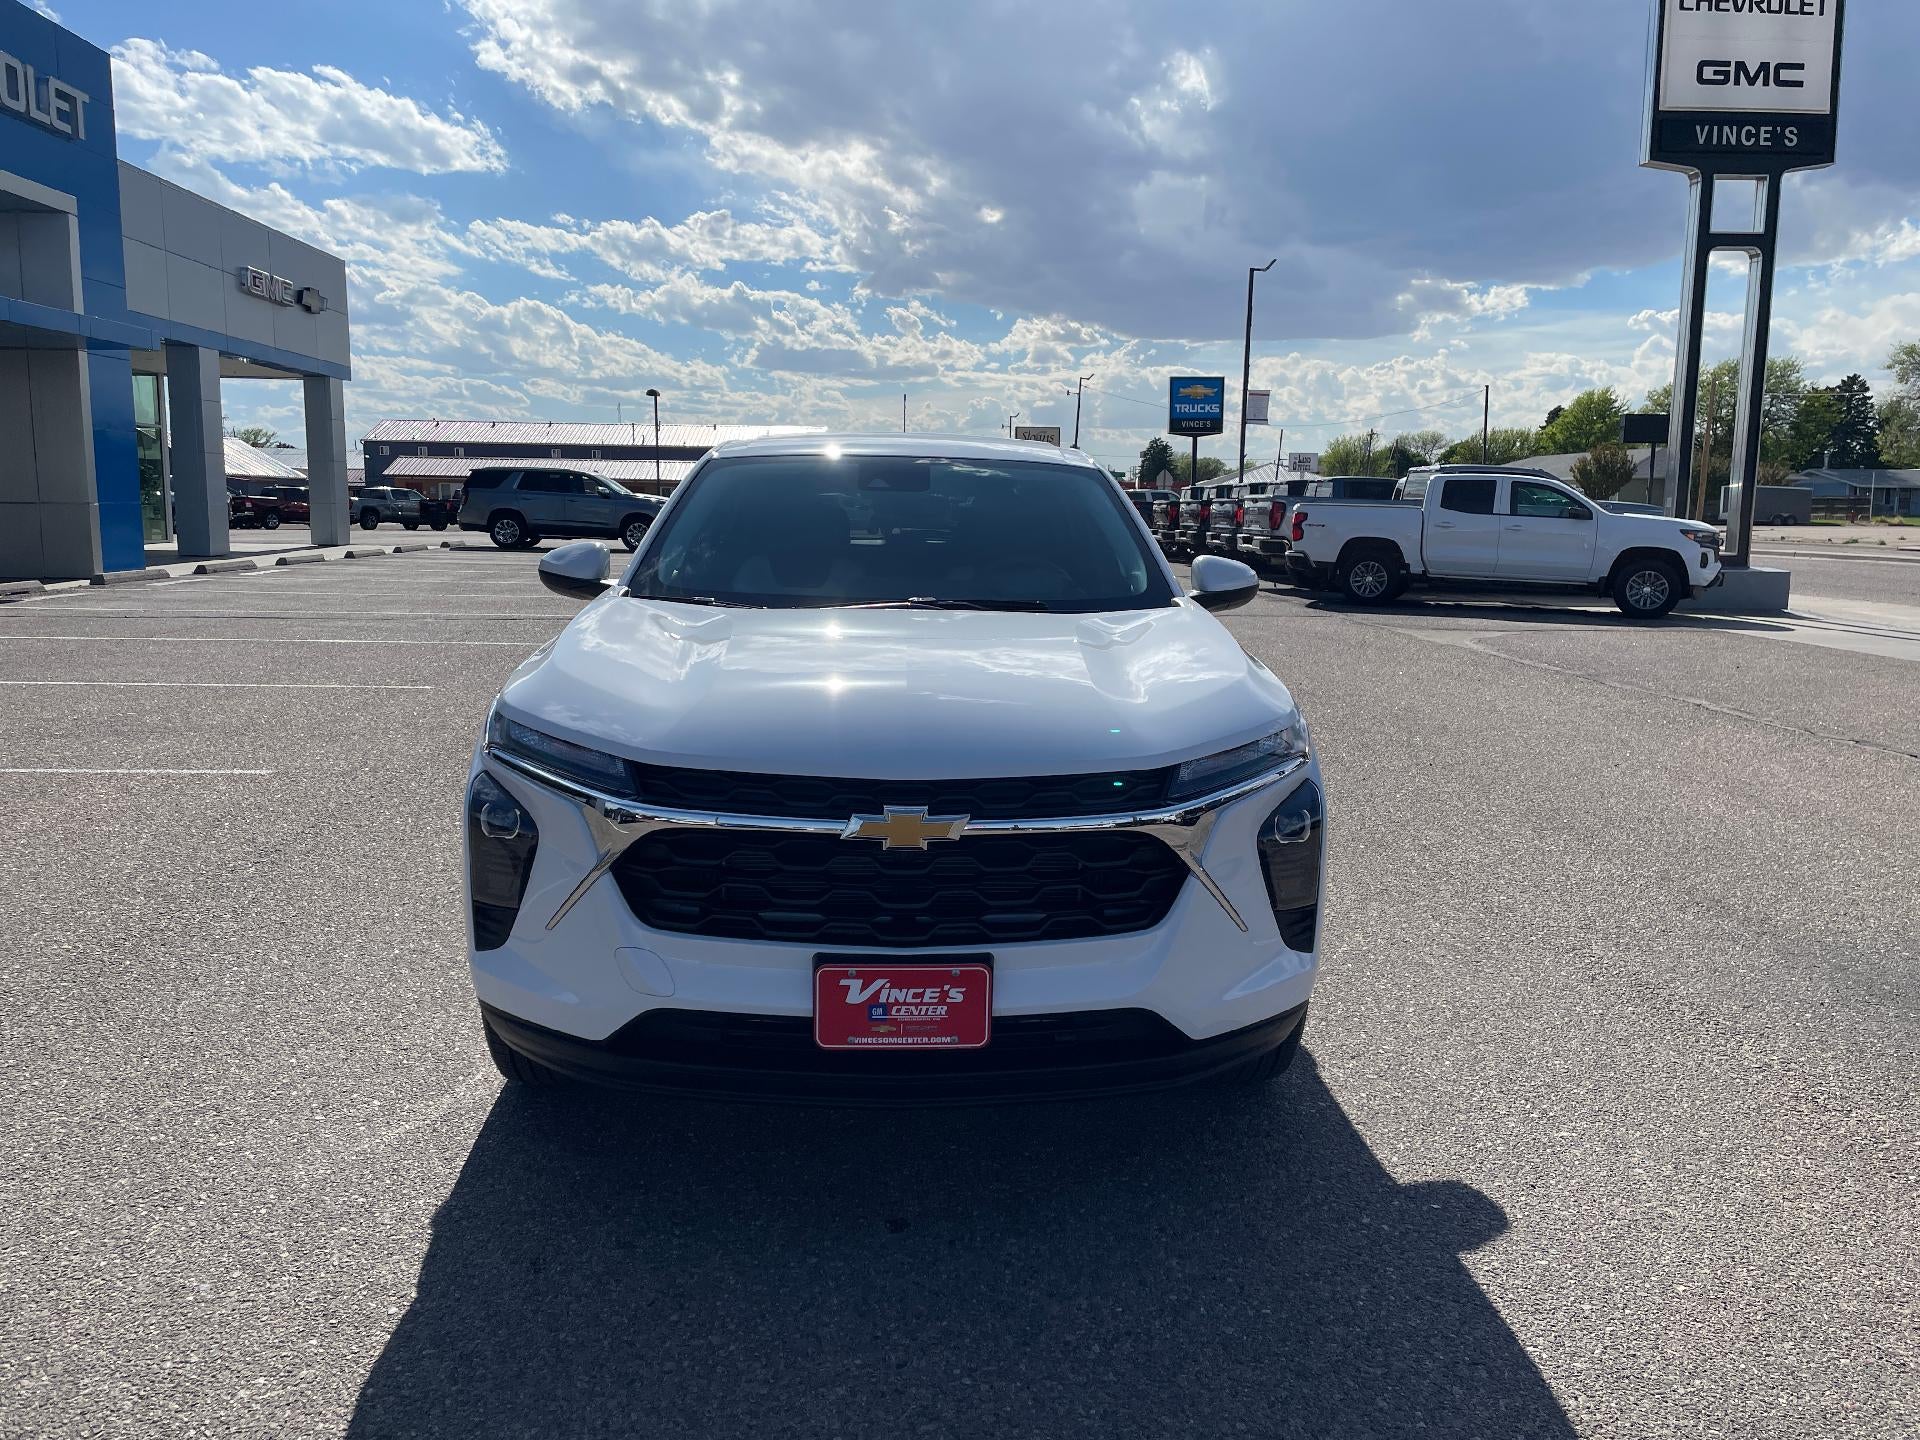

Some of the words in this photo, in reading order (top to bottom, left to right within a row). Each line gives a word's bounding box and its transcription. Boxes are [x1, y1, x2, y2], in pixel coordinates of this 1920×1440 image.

[1696, 60, 1805, 88] GMC
[1695, 124, 1798, 147] VINCE'S
[247, 265, 295, 306] GMC
[1174, 403, 1220, 413] TRUCKS
[1181, 420, 1211, 428] VINCE'S
[839, 978, 967, 1004] VINCE'S
[871, 1008, 883, 1016] GM
[891, 1005, 948, 1016] CENTER
